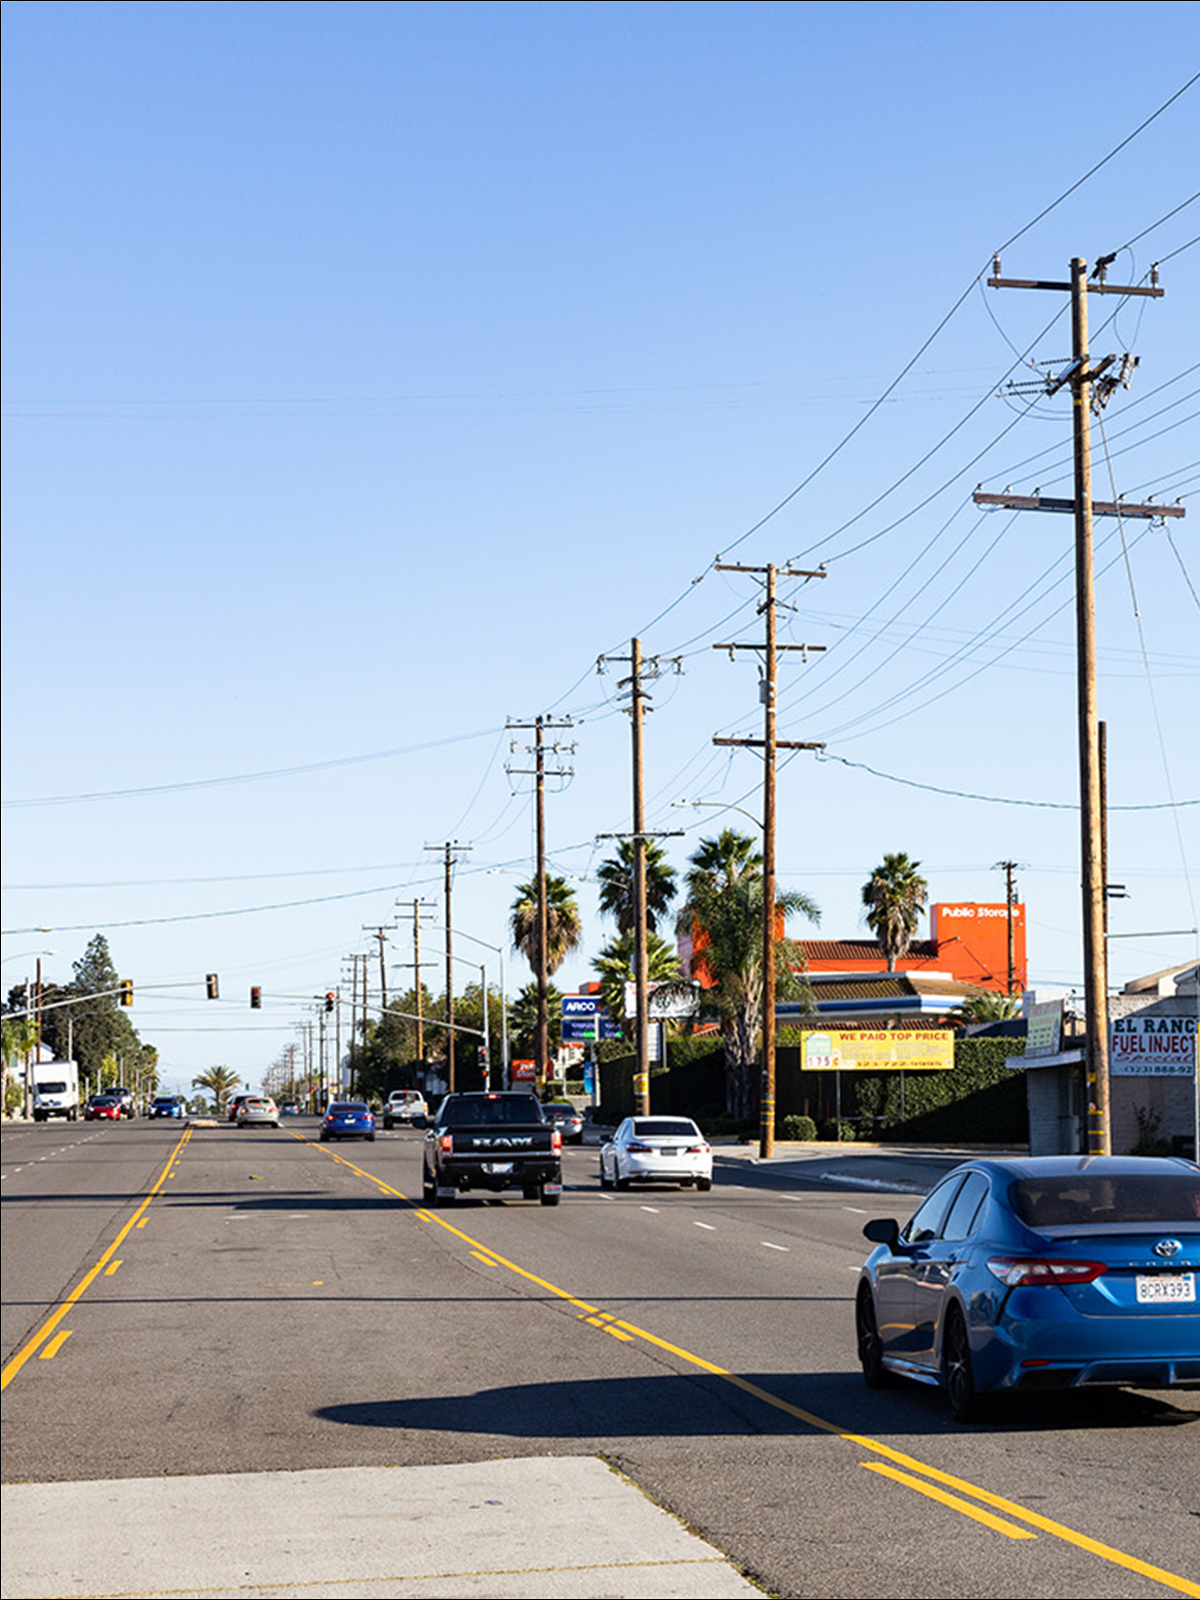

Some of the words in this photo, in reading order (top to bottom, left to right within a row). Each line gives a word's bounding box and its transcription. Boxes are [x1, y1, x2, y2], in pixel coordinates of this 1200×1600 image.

[942, 907, 975, 917] Public
[566, 1002, 596, 1011] ARCO
[1114, 1019, 1137, 1033] EL
[1112, 1035, 1146, 1053] FUEL
[472, 1137, 533, 1147] RAM
[1140, 1282, 1191, 1299] 8CRX393
